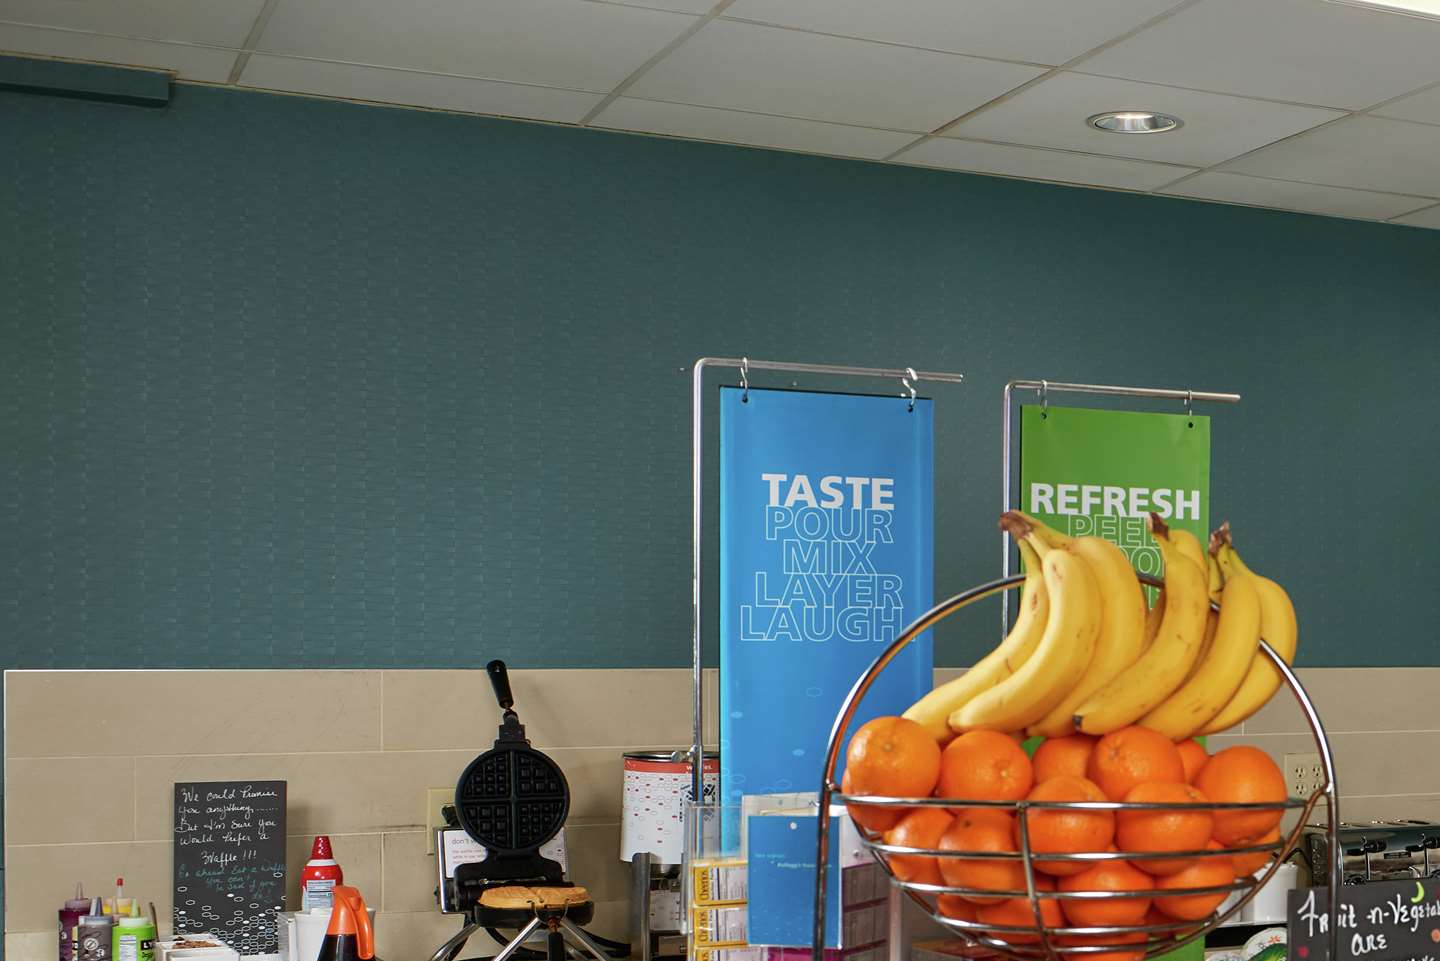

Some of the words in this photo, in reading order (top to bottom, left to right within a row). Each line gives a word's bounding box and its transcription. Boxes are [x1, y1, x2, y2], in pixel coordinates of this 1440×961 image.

[761, 473, 895, 511] TASTE
[1030, 482, 1201, 521] REFRESH
[765, 505, 894, 544] POUR
[783, 538, 878, 576] MIX
[755, 571, 904, 609] LAYER
[180, 785, 199, 803] We
[206, 788, 236, 802] could
[174, 818, 199, 833] But
